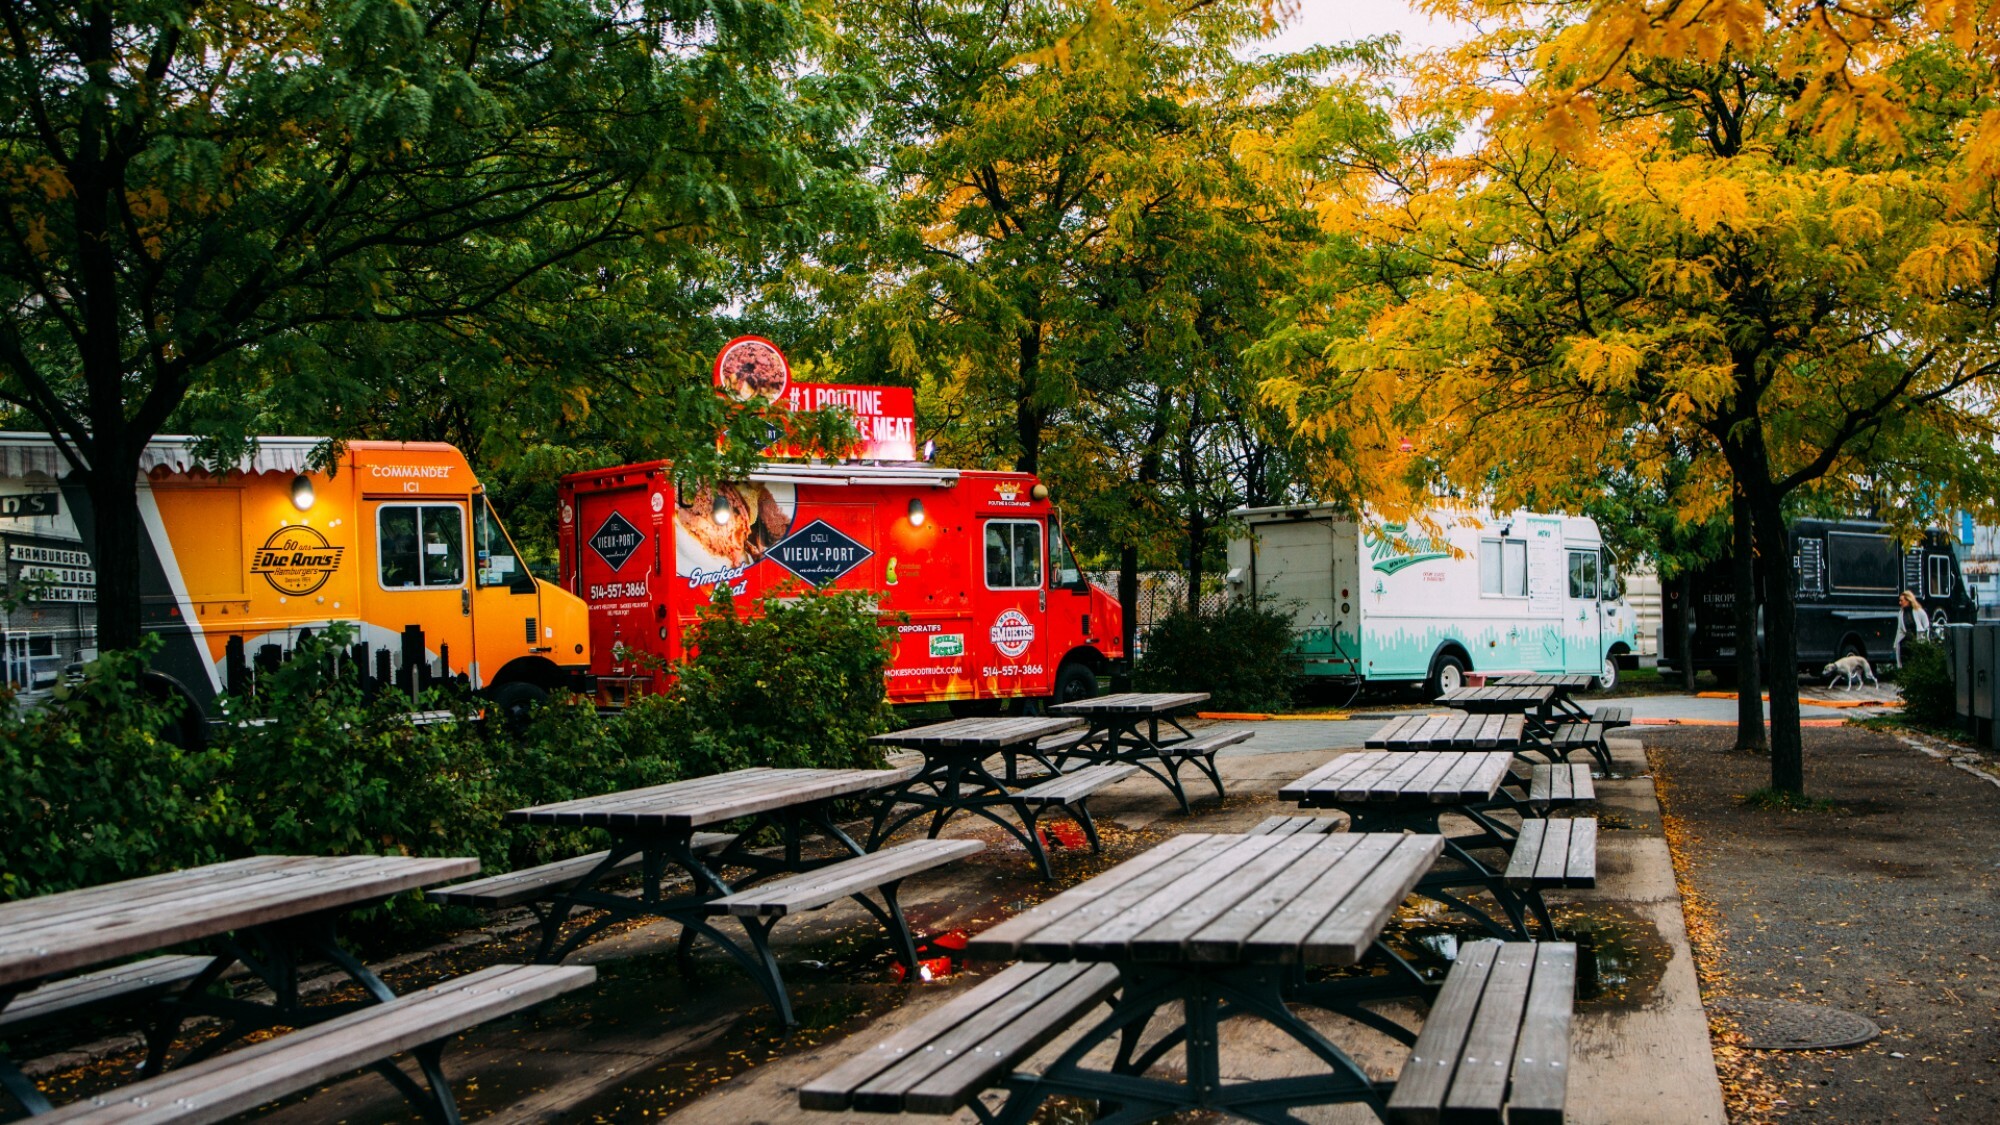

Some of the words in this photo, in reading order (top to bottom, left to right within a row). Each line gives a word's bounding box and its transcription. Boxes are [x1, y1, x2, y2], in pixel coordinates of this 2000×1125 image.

[789, 387, 811, 412] #1
[815, 389, 883, 415] POUTINE
[873, 417, 912, 441] MEAT
[372, 466, 449, 478] COMMANDEZ
[403, 481, 419, 492] ICI
[597, 533, 635, 549] VIEUX-PORT
[811, 533, 828, 543] DELI
[283, 539, 298, 550] 60
[17, 547, 88, 567] HAMBURGERS
[783, 547, 854, 561] VIEUX-PORT
[274, 568, 318, 576] Hamburgers
[689, 561, 746, 588] Smoked
[41, 588, 73, 600] RENCH
[77, 588, 97, 601] FRIE
[590, 582, 646, 599] 514-557-3866
[1703, 593, 1736, 603] EUROPE
[897, 624, 942, 632] ORPORATIFS
[991, 626, 1034, 643] SMOKIES
[884, 667, 963, 677] MOKIESFOODTRUCK.COM
[983, 665, 1043, 677] 514-557-3866
